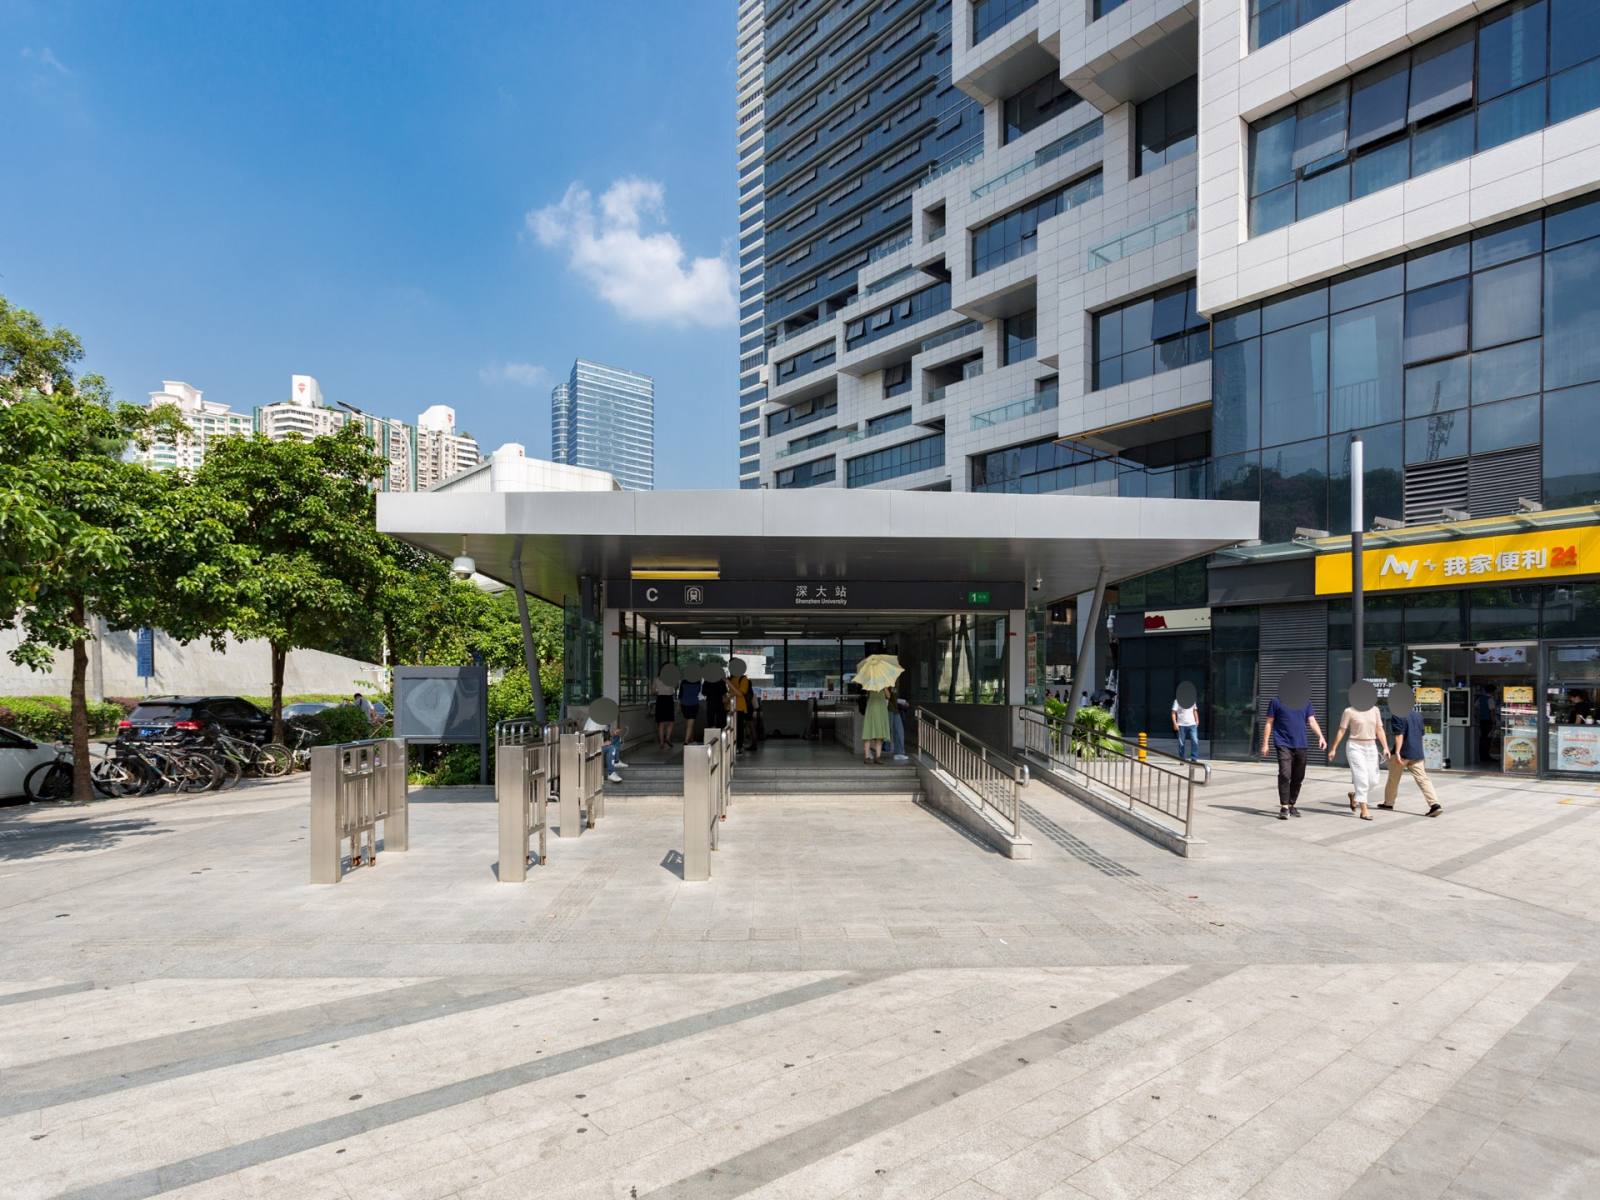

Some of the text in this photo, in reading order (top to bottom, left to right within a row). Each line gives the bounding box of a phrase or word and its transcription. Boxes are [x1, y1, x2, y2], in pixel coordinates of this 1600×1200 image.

[1551, 545, 1577, 561] 24
[1444, 547, 1547, 577] 我家便利
[646, 588, 659, 602] C
[796, 585, 847, 597] 深大站
[971, 593, 977, 602] 1
[138, 628, 144, 639] P
